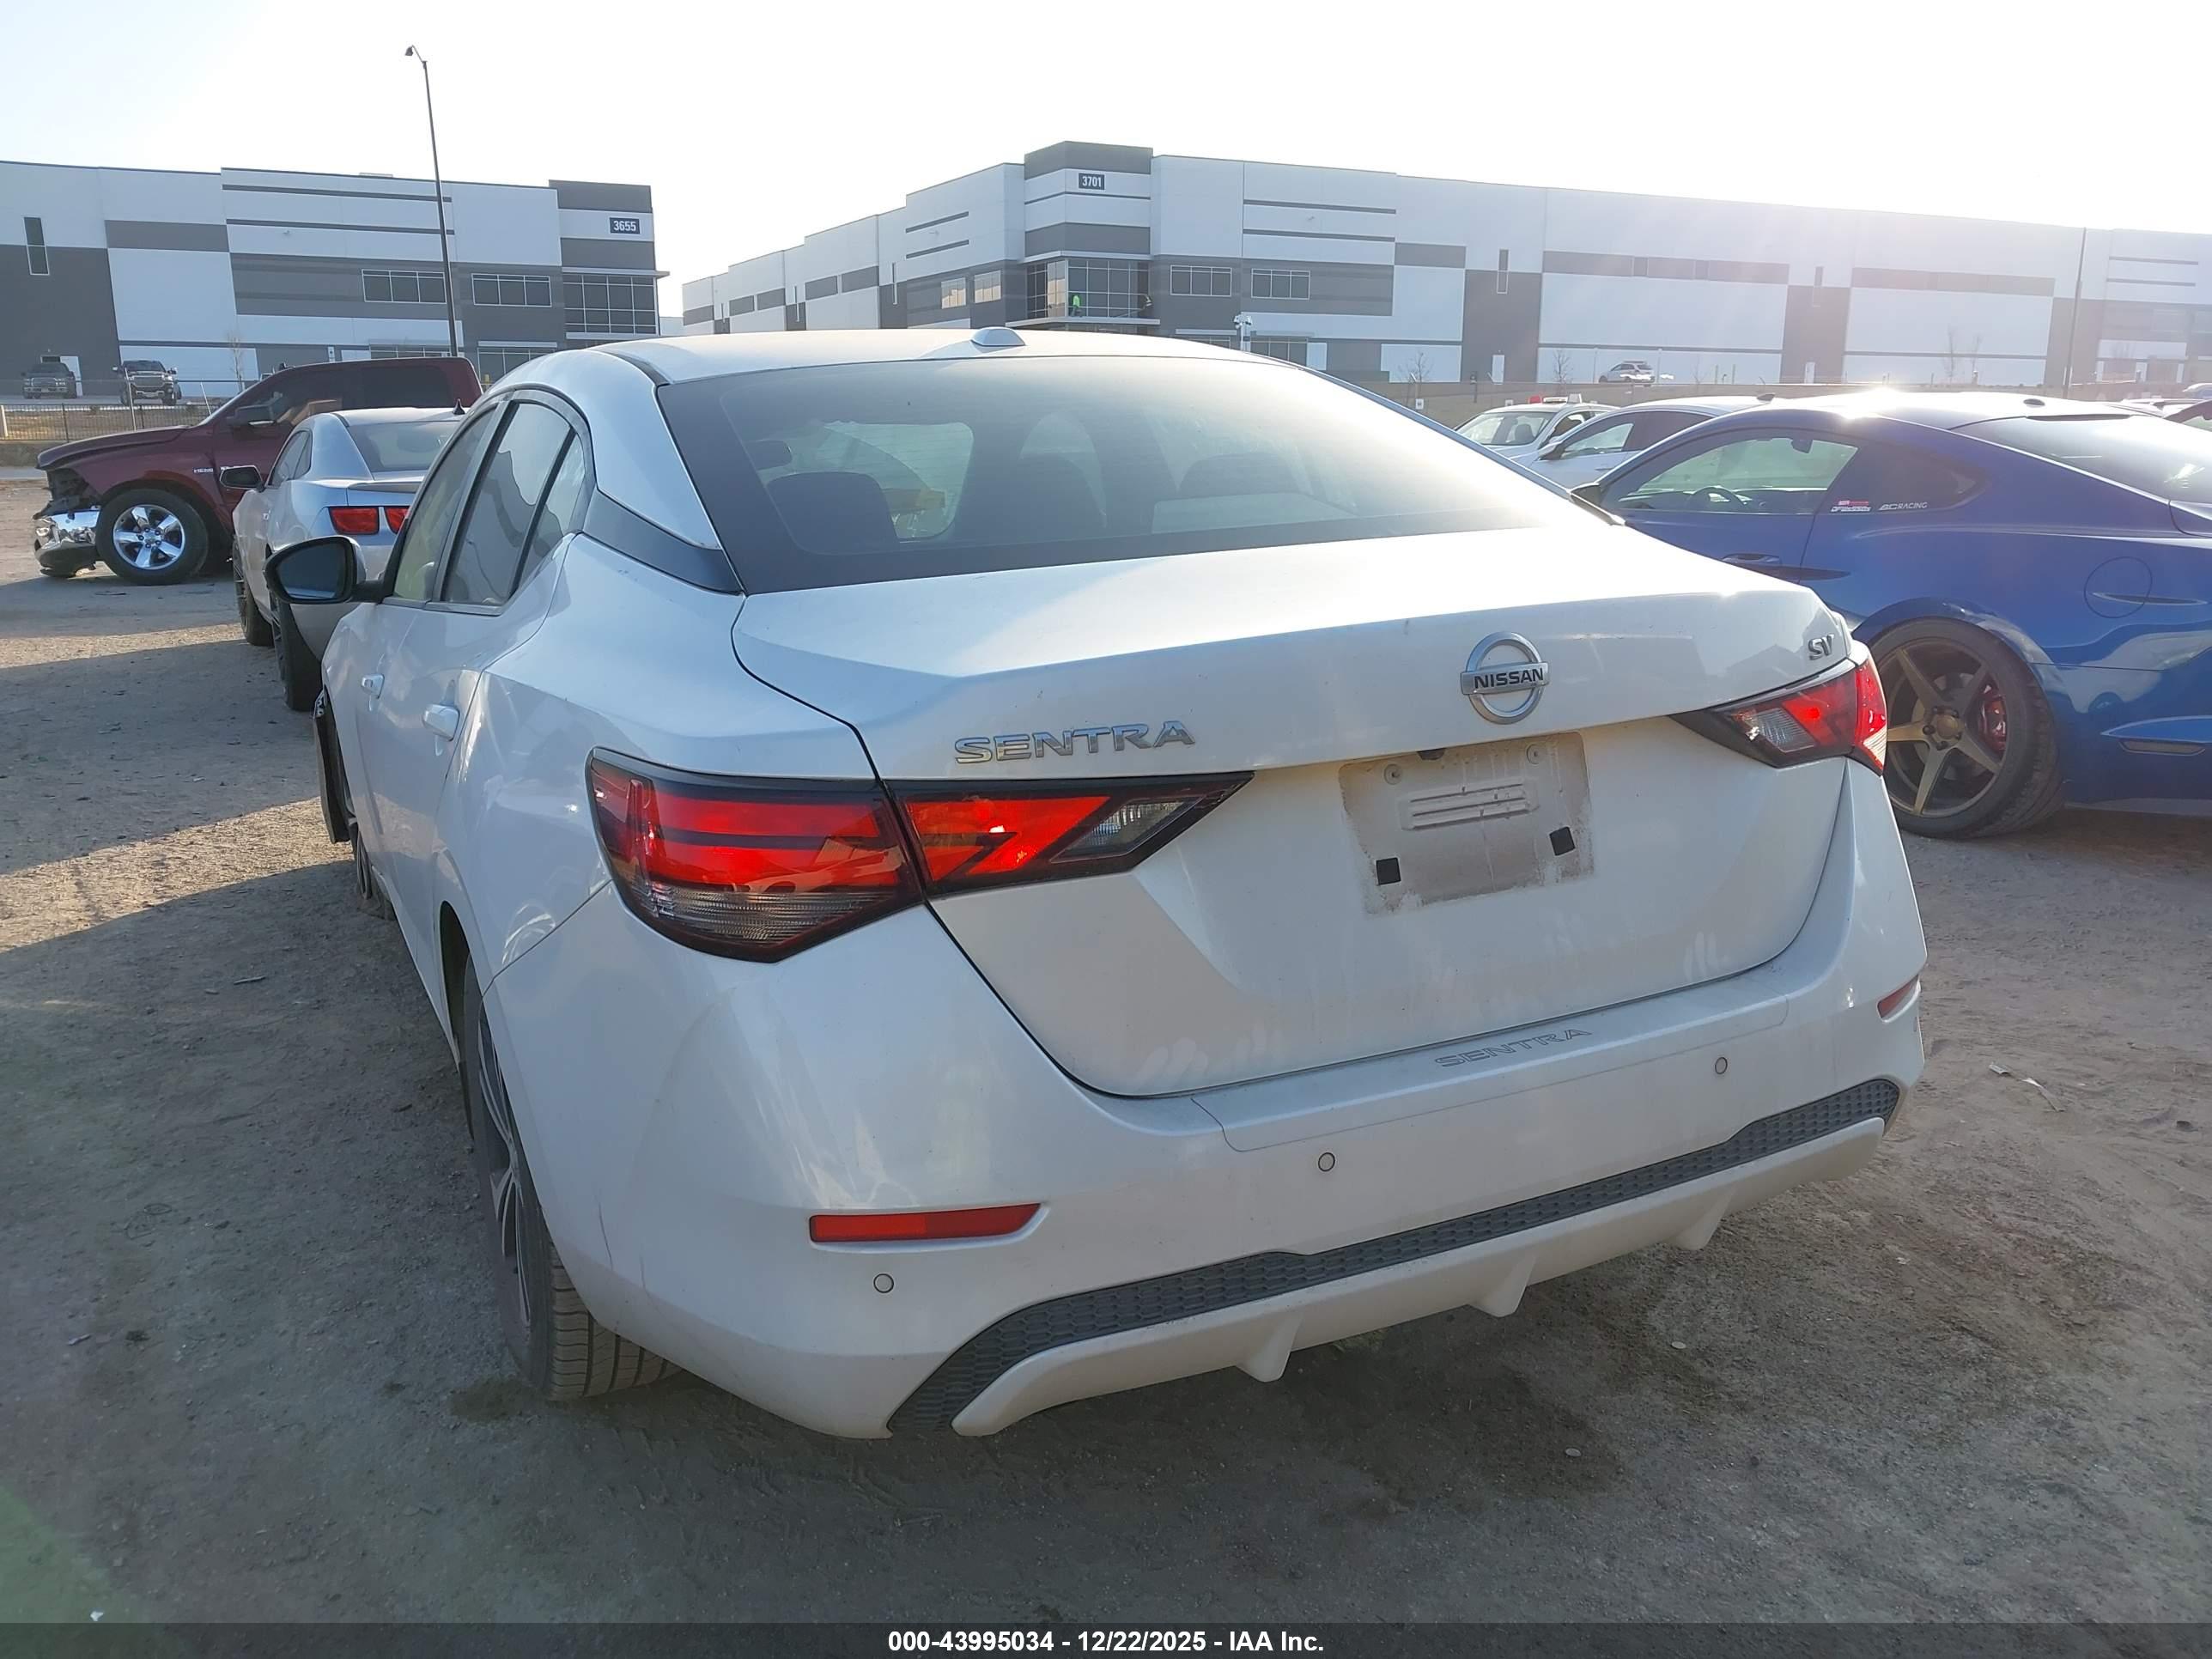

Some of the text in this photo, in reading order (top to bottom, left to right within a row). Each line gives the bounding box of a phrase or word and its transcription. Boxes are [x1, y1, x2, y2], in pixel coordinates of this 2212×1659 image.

[1082, 176, 1102, 187] 3701
[613, 220, 637, 232] 3655
[1808, 634, 1835, 660] SV
[1474, 667, 1544, 690] NISSAN
[954, 720, 1196, 764] SENTRA
[1434, 1029, 1592, 1067] SENTRA
